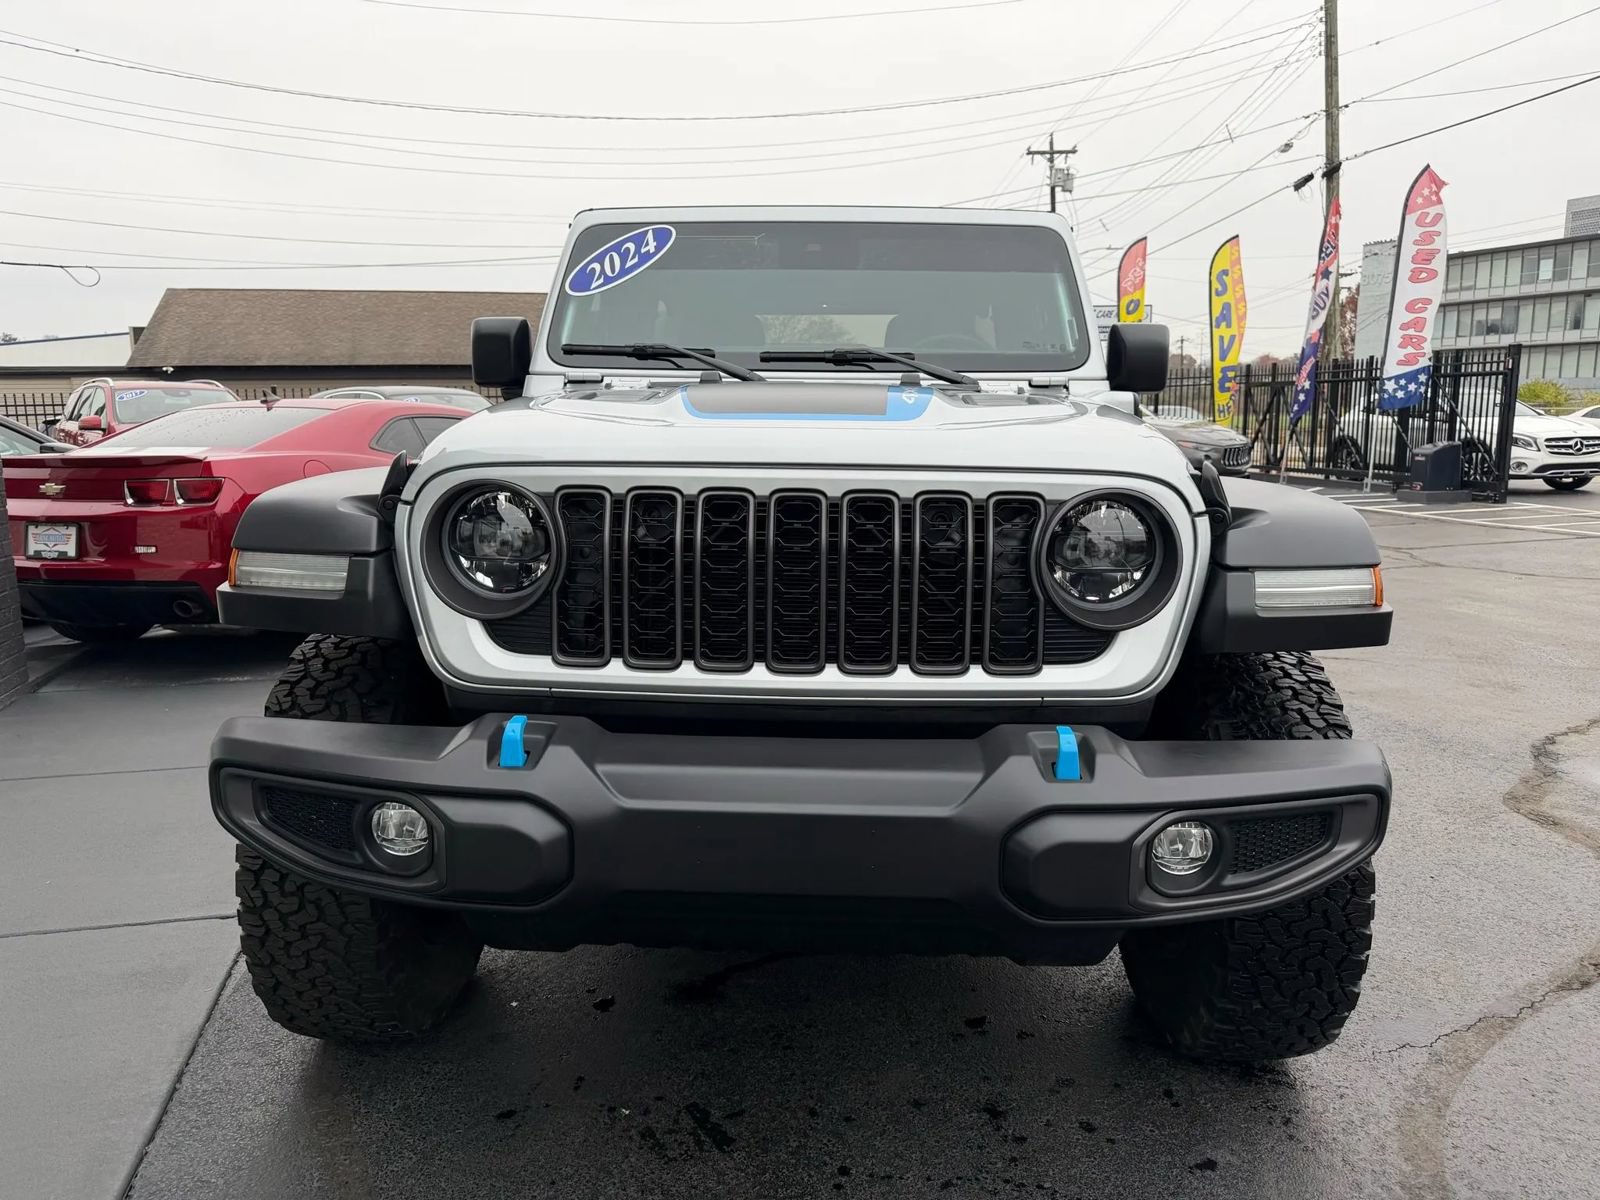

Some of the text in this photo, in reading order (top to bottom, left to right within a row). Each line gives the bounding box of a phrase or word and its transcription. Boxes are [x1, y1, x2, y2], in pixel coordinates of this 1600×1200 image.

[586, 228, 657, 290] 2024
[1396, 211, 1444, 367] USED CARS
[1214, 269, 1239, 393] SAVE
